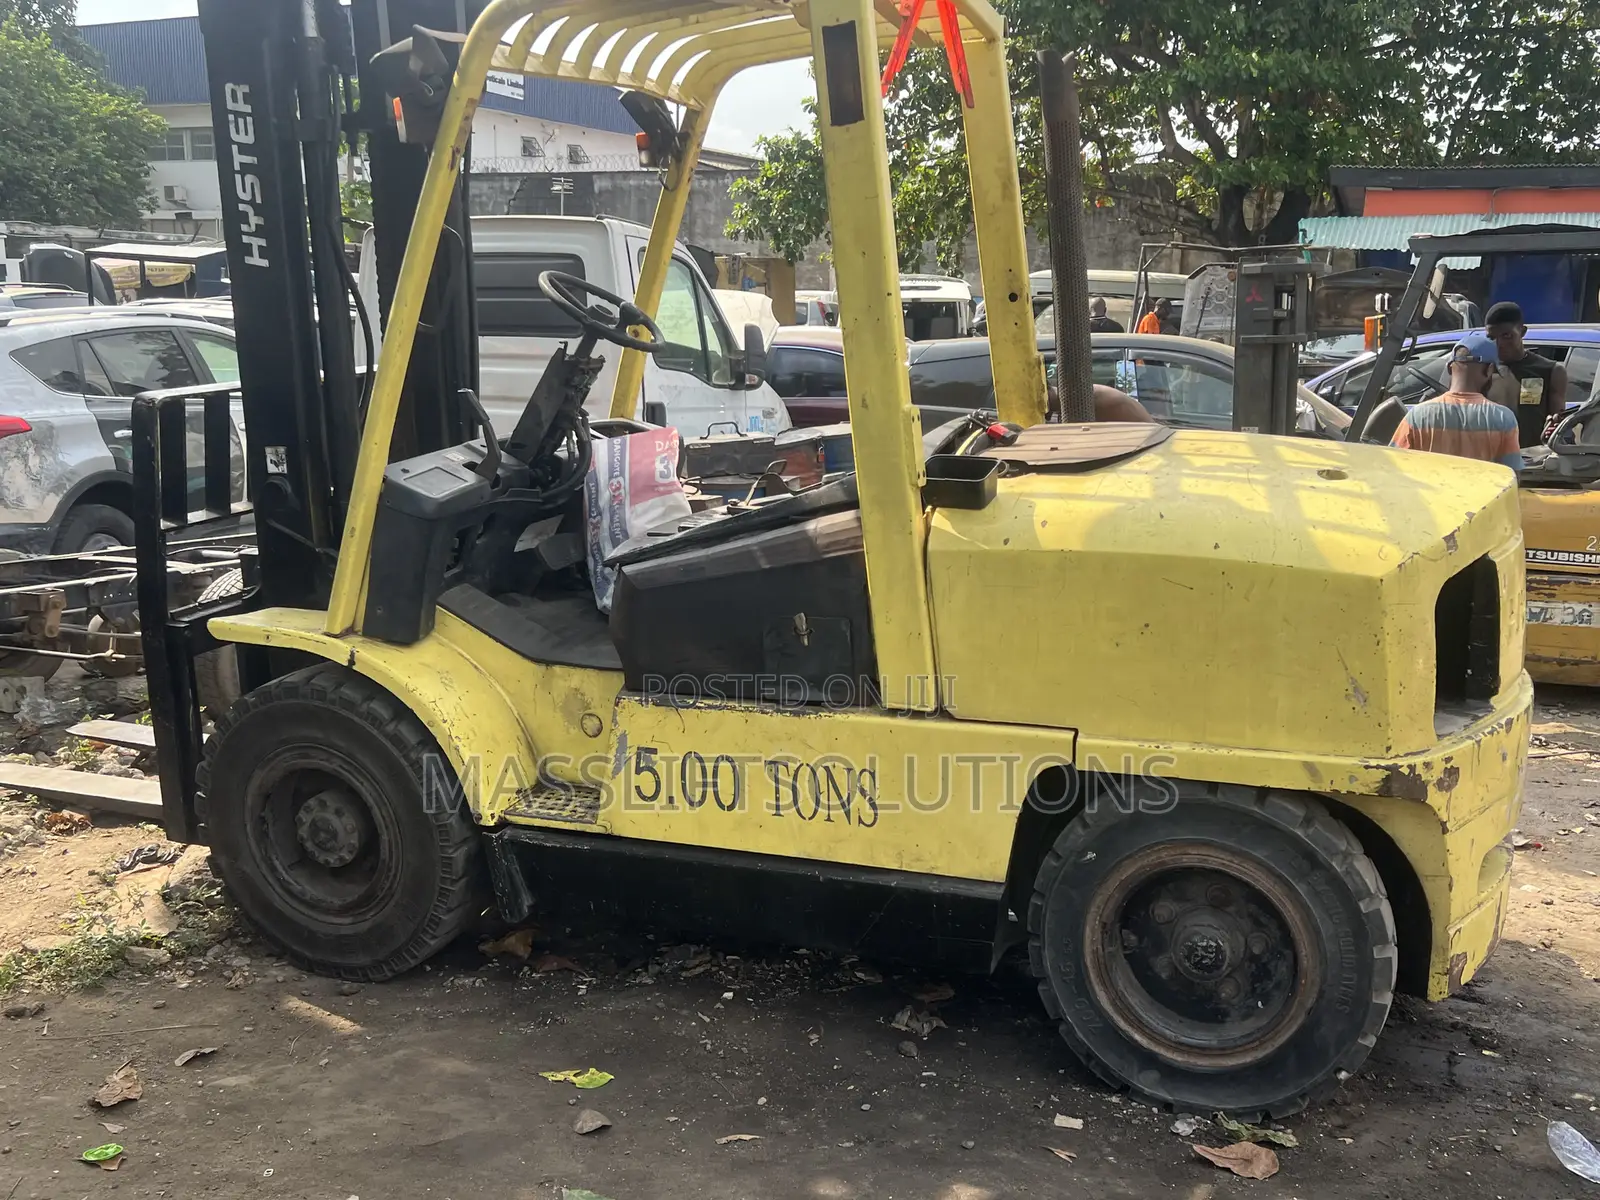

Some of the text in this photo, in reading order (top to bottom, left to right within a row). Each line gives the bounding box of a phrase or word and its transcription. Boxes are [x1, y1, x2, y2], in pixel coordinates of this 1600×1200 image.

[225, 82, 269, 267] HYSTER
[634, 746, 879, 827] 5.00 TONS
